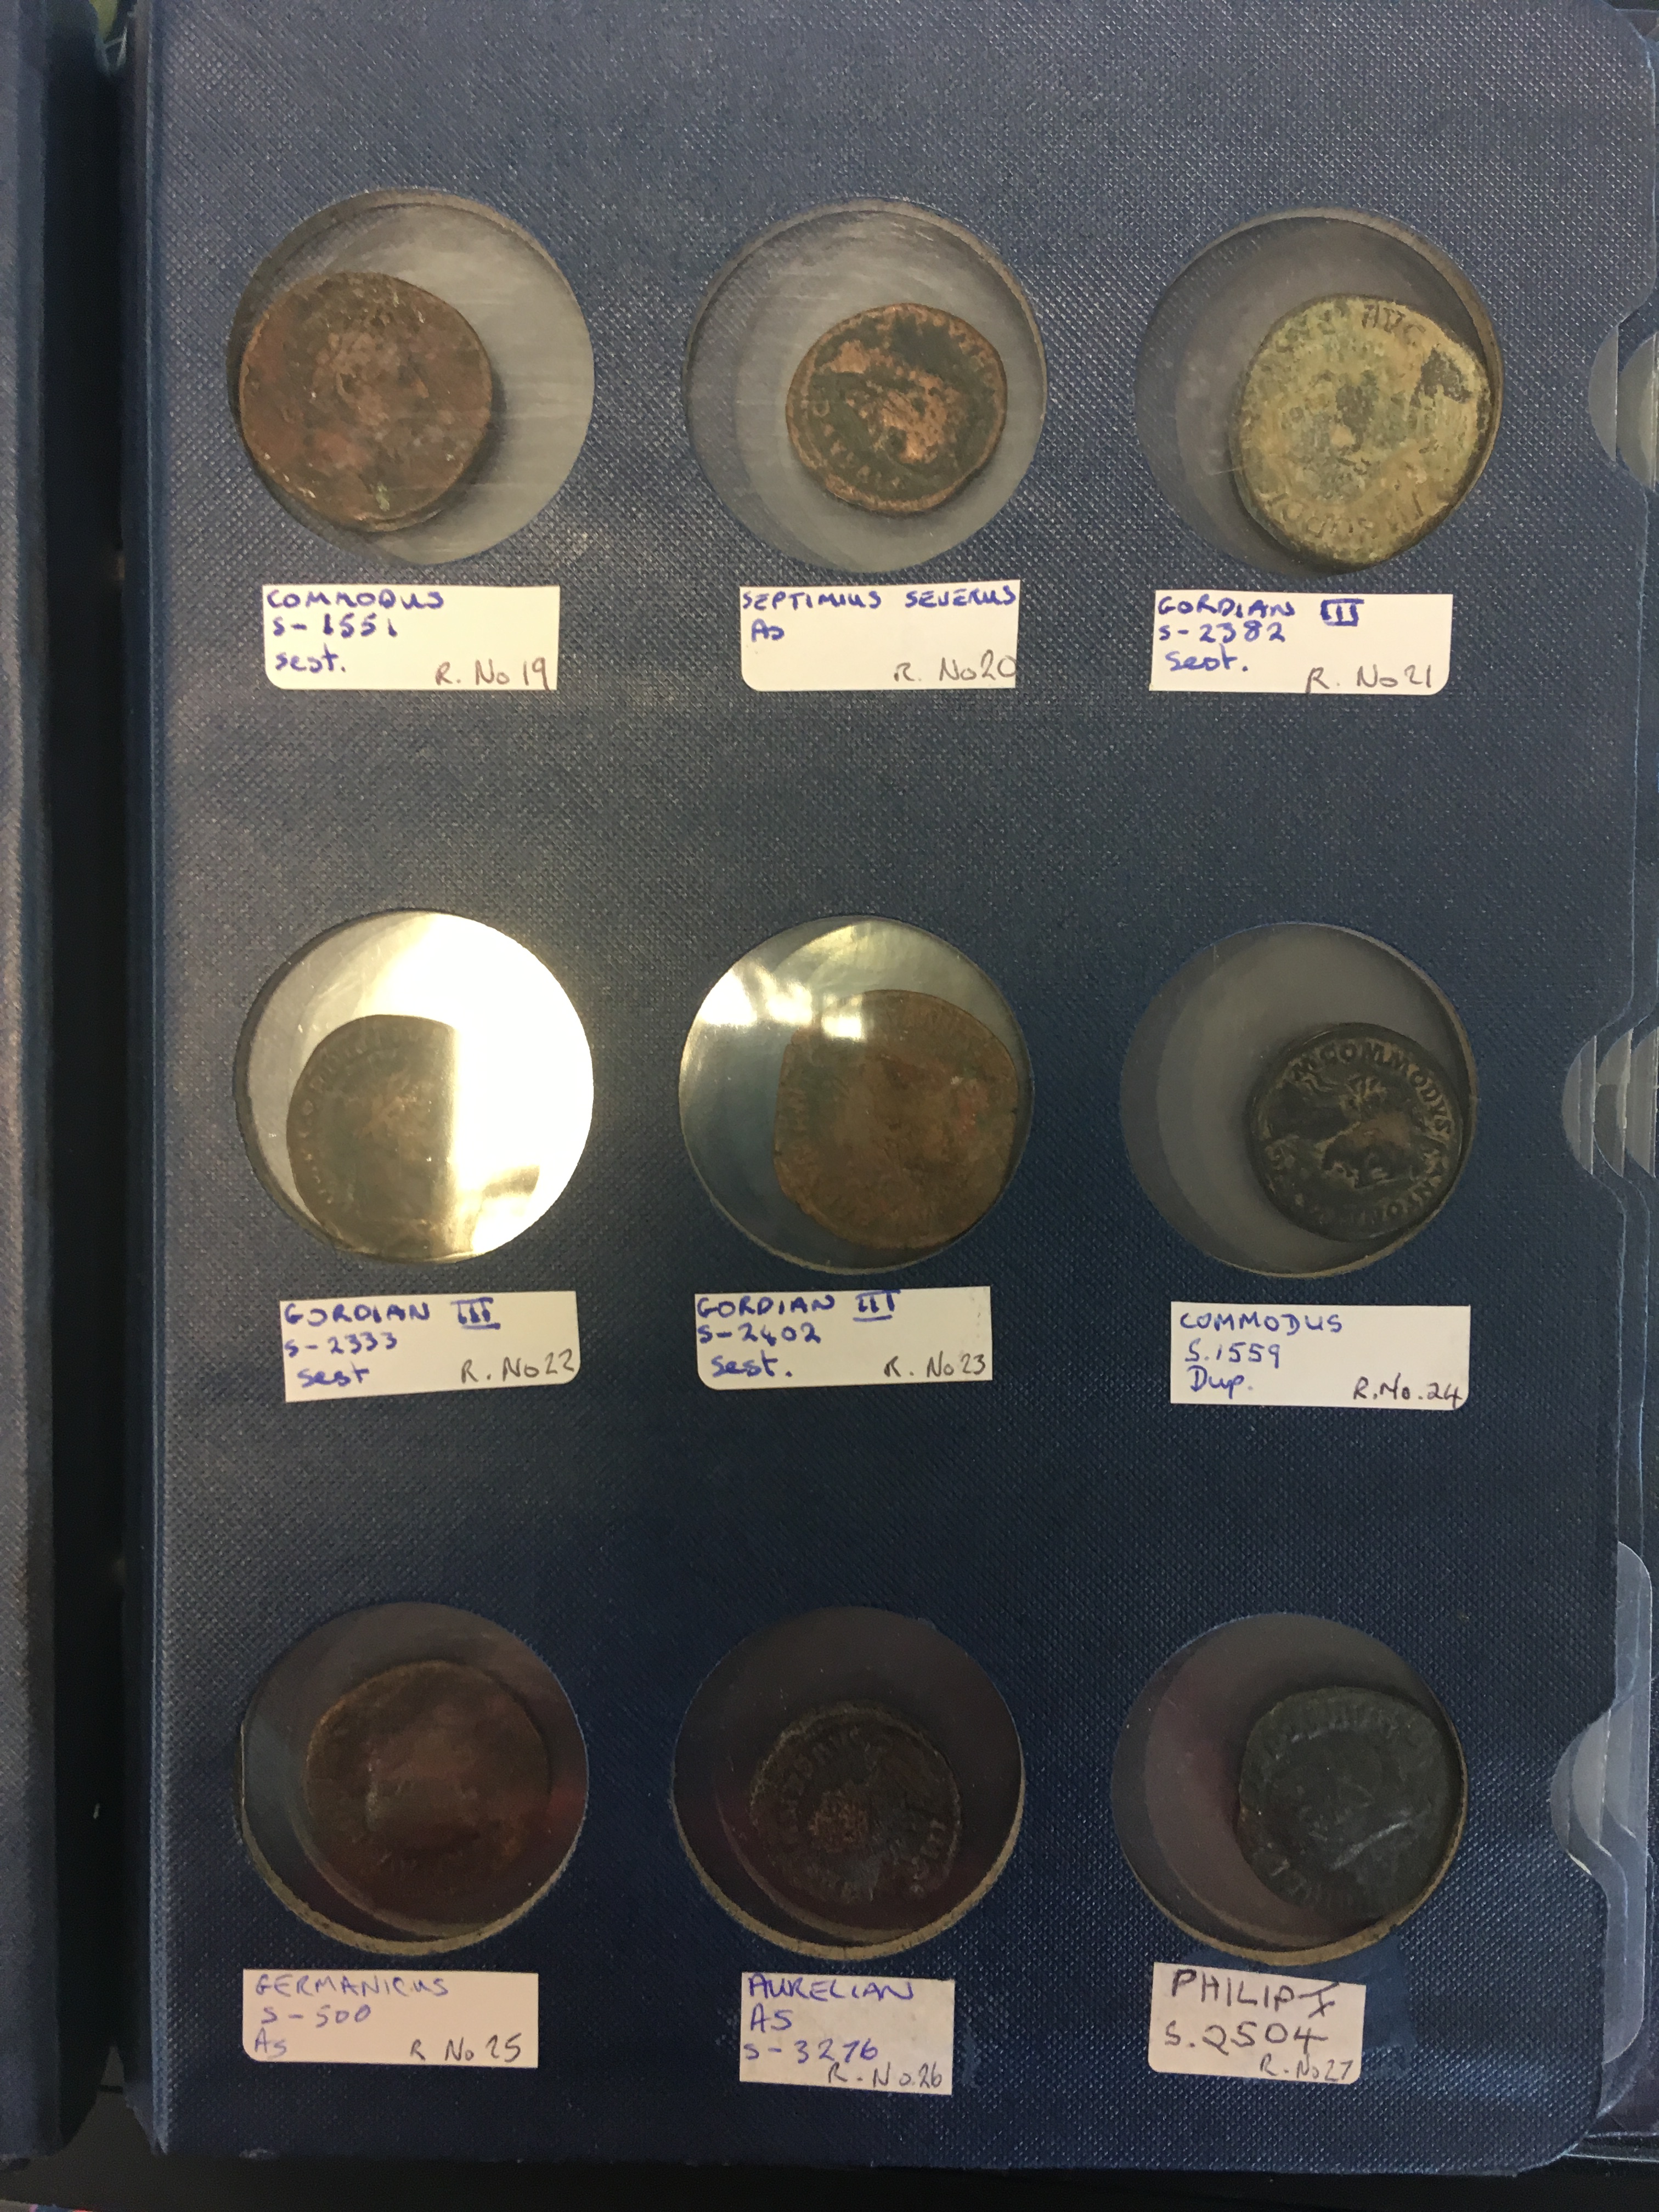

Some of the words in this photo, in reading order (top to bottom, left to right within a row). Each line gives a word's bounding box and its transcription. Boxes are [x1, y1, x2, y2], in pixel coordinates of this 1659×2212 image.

[905, 586, 1016, 608] SEVERUS
[1158, 594, 1295, 618] GORDIAN
[284, 1302, 430, 1326] GORDIAN
[450, 1297, 501, 1329] III
[697, 1295, 835, 1318] GORDIAN
[853, 1289, 901, 1322] III
[1180, 1311, 1342, 1336] COMMODUS
[1187, 1365, 1253, 1398] Dup.
[256, 1974, 449, 1997] GERMANICUS
[747, 1972, 914, 2001] AURELIAN
[1172, 1968, 1295, 2012] PHILIP
